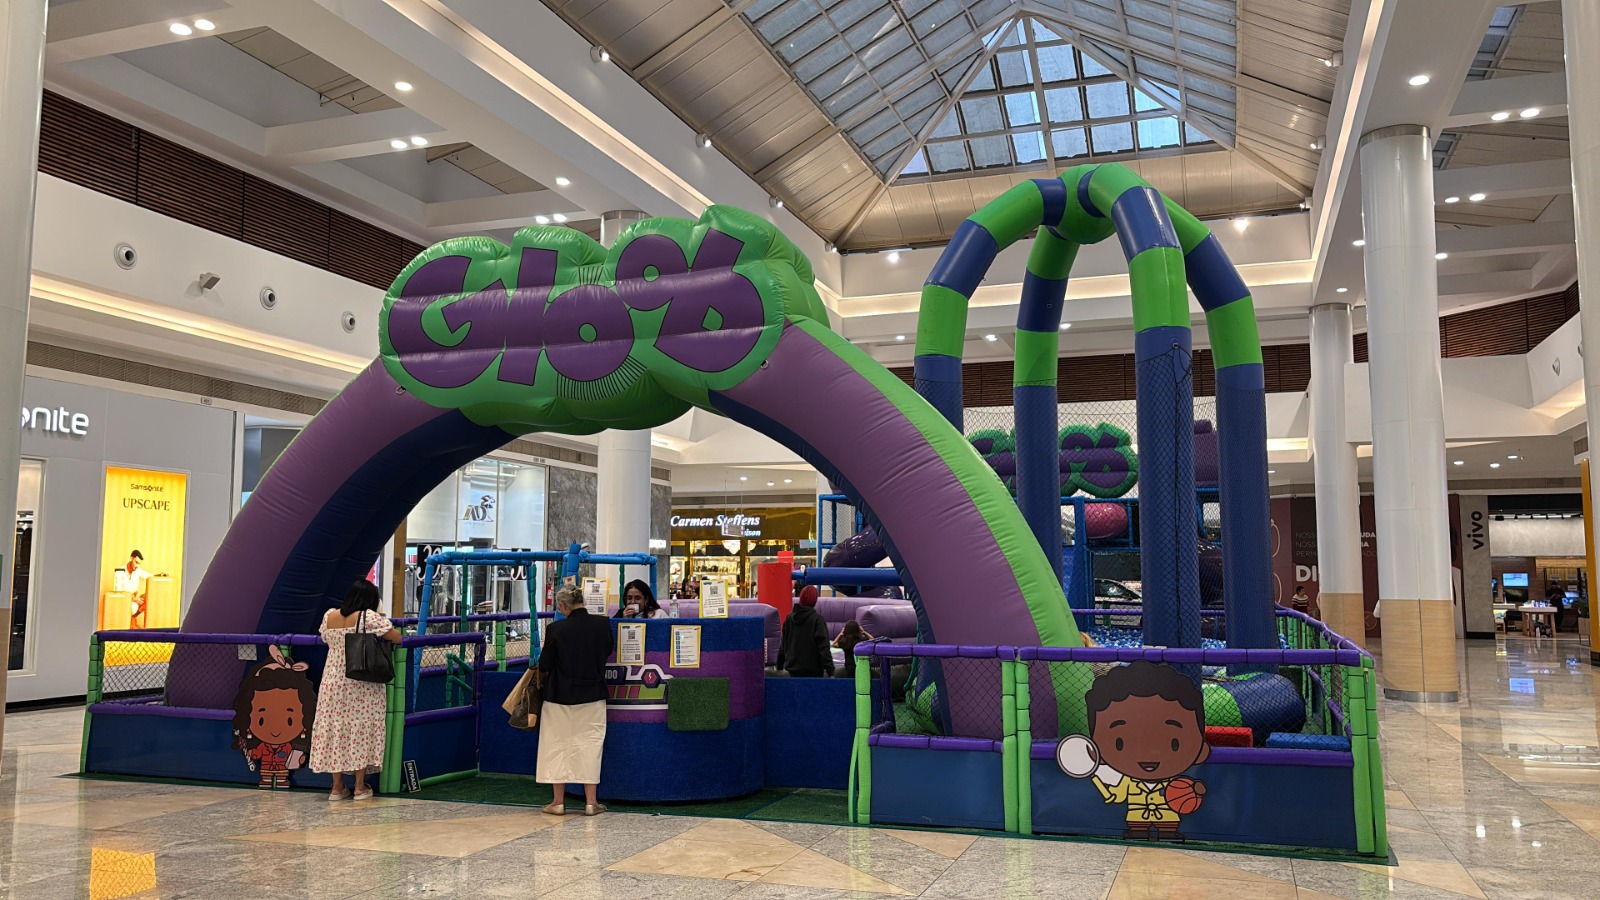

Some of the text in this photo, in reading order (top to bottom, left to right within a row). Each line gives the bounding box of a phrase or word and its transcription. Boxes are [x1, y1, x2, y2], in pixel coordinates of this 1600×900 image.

[387, 226, 765, 389] Gloob
[123, 497, 171, 511] UPSCAPE
[670, 514, 760, 527] Carmen Steffens
[1295, 531, 1316, 539] NOSS
[1466, 511, 1485, 550] vivo
[1296, 565, 1318, 582] DI
[407, 762, 418, 791] ENTRADA
